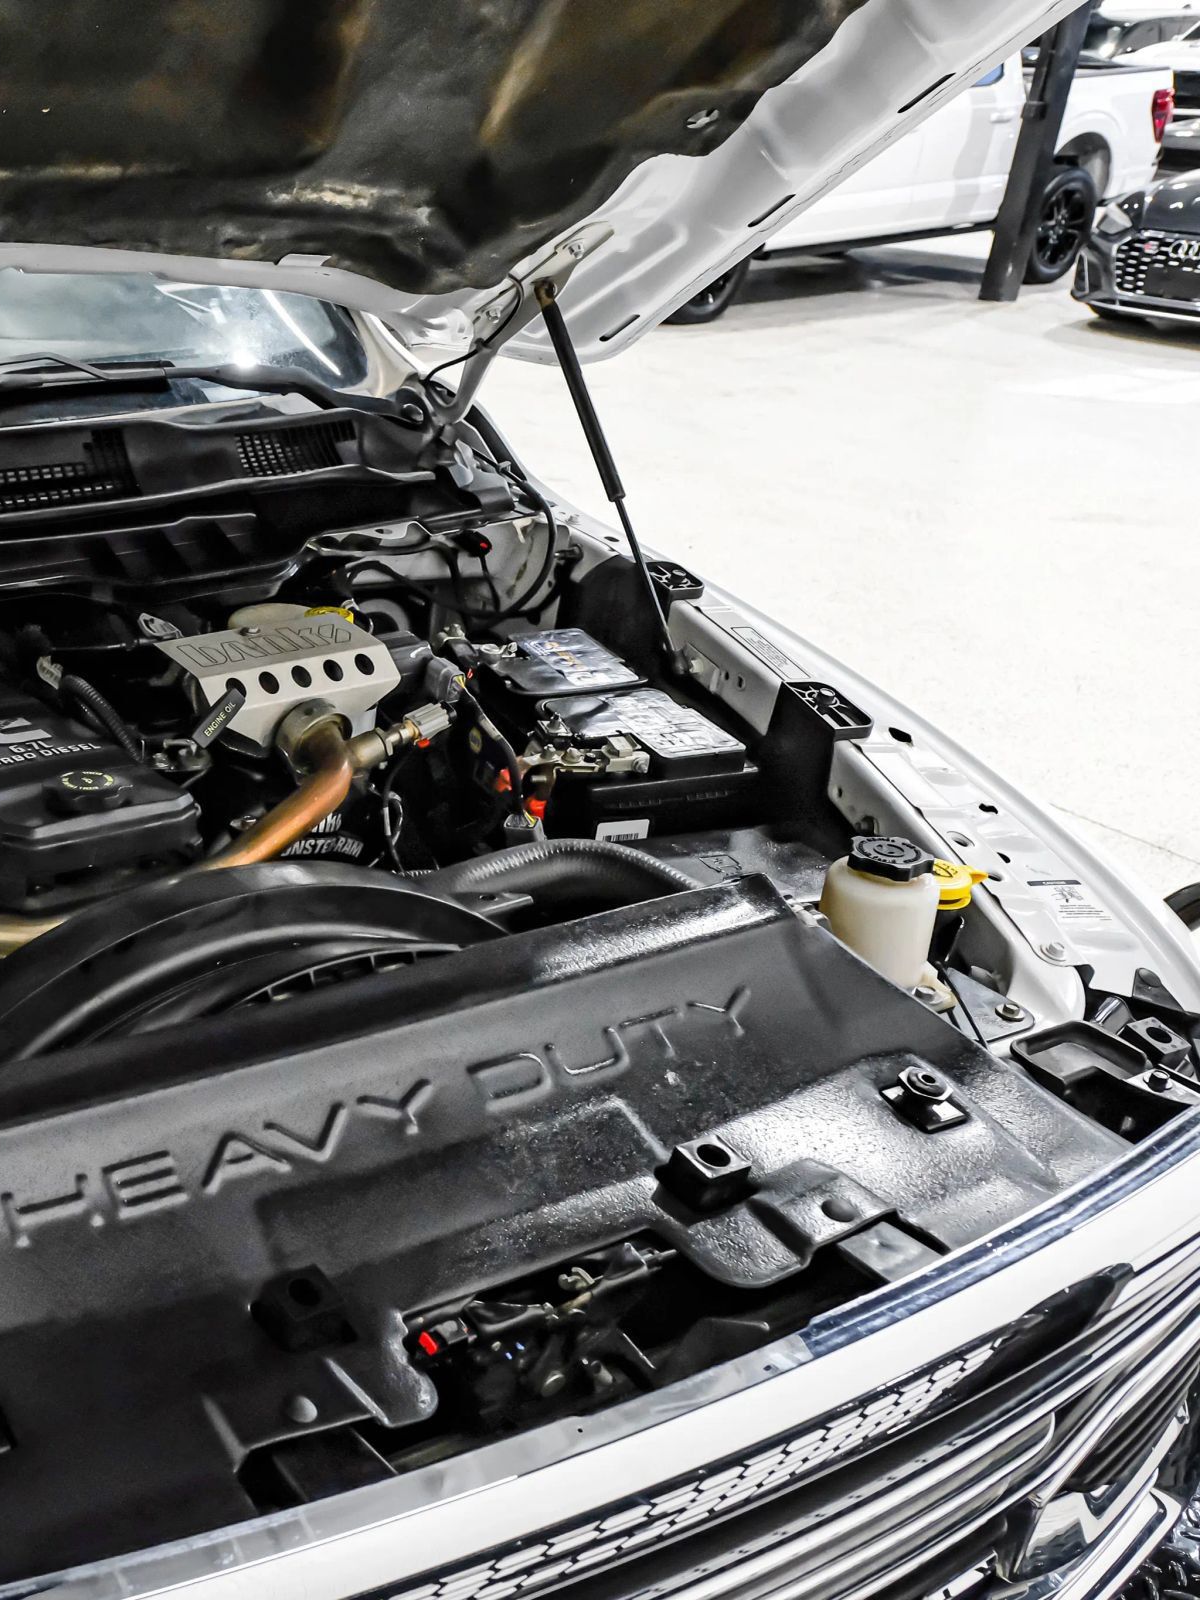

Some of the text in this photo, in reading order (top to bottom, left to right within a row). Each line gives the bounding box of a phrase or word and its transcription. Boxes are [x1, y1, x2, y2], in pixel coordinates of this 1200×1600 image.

[176, 623, 352, 668] banks
[203, 701, 237, 737] ENGINE OIL
[8, 740, 54, 754] 6.7L
[39, 742, 102, 757] DIESEL
[0, 985, 750, 1249] HEAVY DUTY
